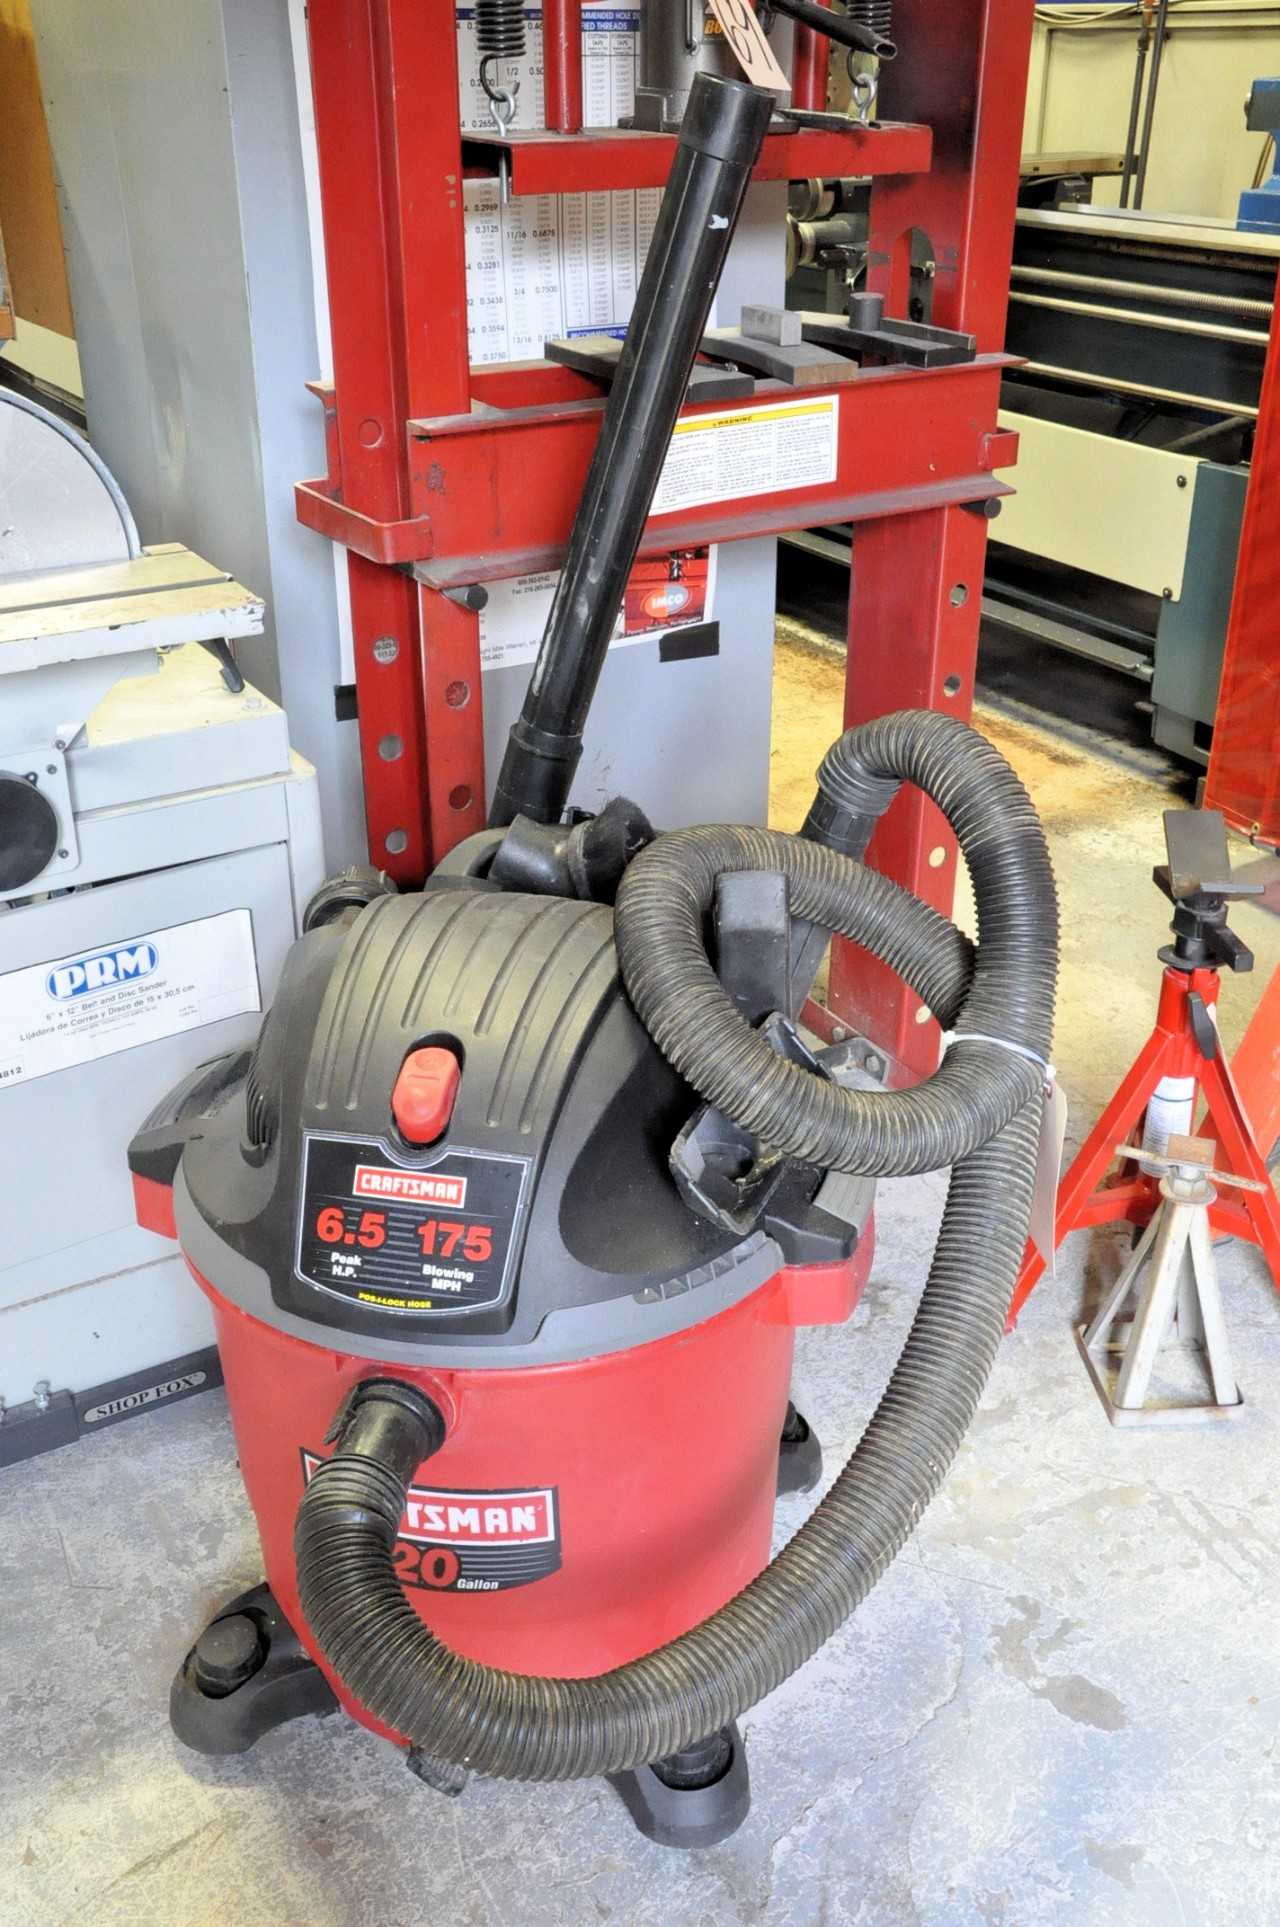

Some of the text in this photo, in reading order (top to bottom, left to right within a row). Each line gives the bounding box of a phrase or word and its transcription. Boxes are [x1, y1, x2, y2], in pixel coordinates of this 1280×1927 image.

[597, 21, 627, 30] THREADS
[475, 225, 499, 234] 0.3125
[718, 416, 752, 426] WARNING
[54, 946, 151, 998] PRM
[100, 995, 116, 1004] and
[118, 990, 136, 1000] Disc
[138, 981, 167, 993] Sander
[20, 1027, 55, 1042] Lijadora
[70, 1014, 99, 1026] Correa
[108, 1003, 132, 1015] Disco
[134, 999, 144, 1008] de
[361, 1173, 459, 1201] CRAFTSMAN
[316, 1207, 493, 1262] 6.5 175
[331, 1252, 362, 1266] Peak
[332, 1265, 357, 1278] H.P.
[422, 1264, 474, 1283] Blowing
[432, 1278, 462, 1292] MPH
[407, 1300, 432, 1308] HOSE
[97, 1376, 194, 1418] SHOP FOX
[394, 1542, 499, 1591] 20 Gallon
